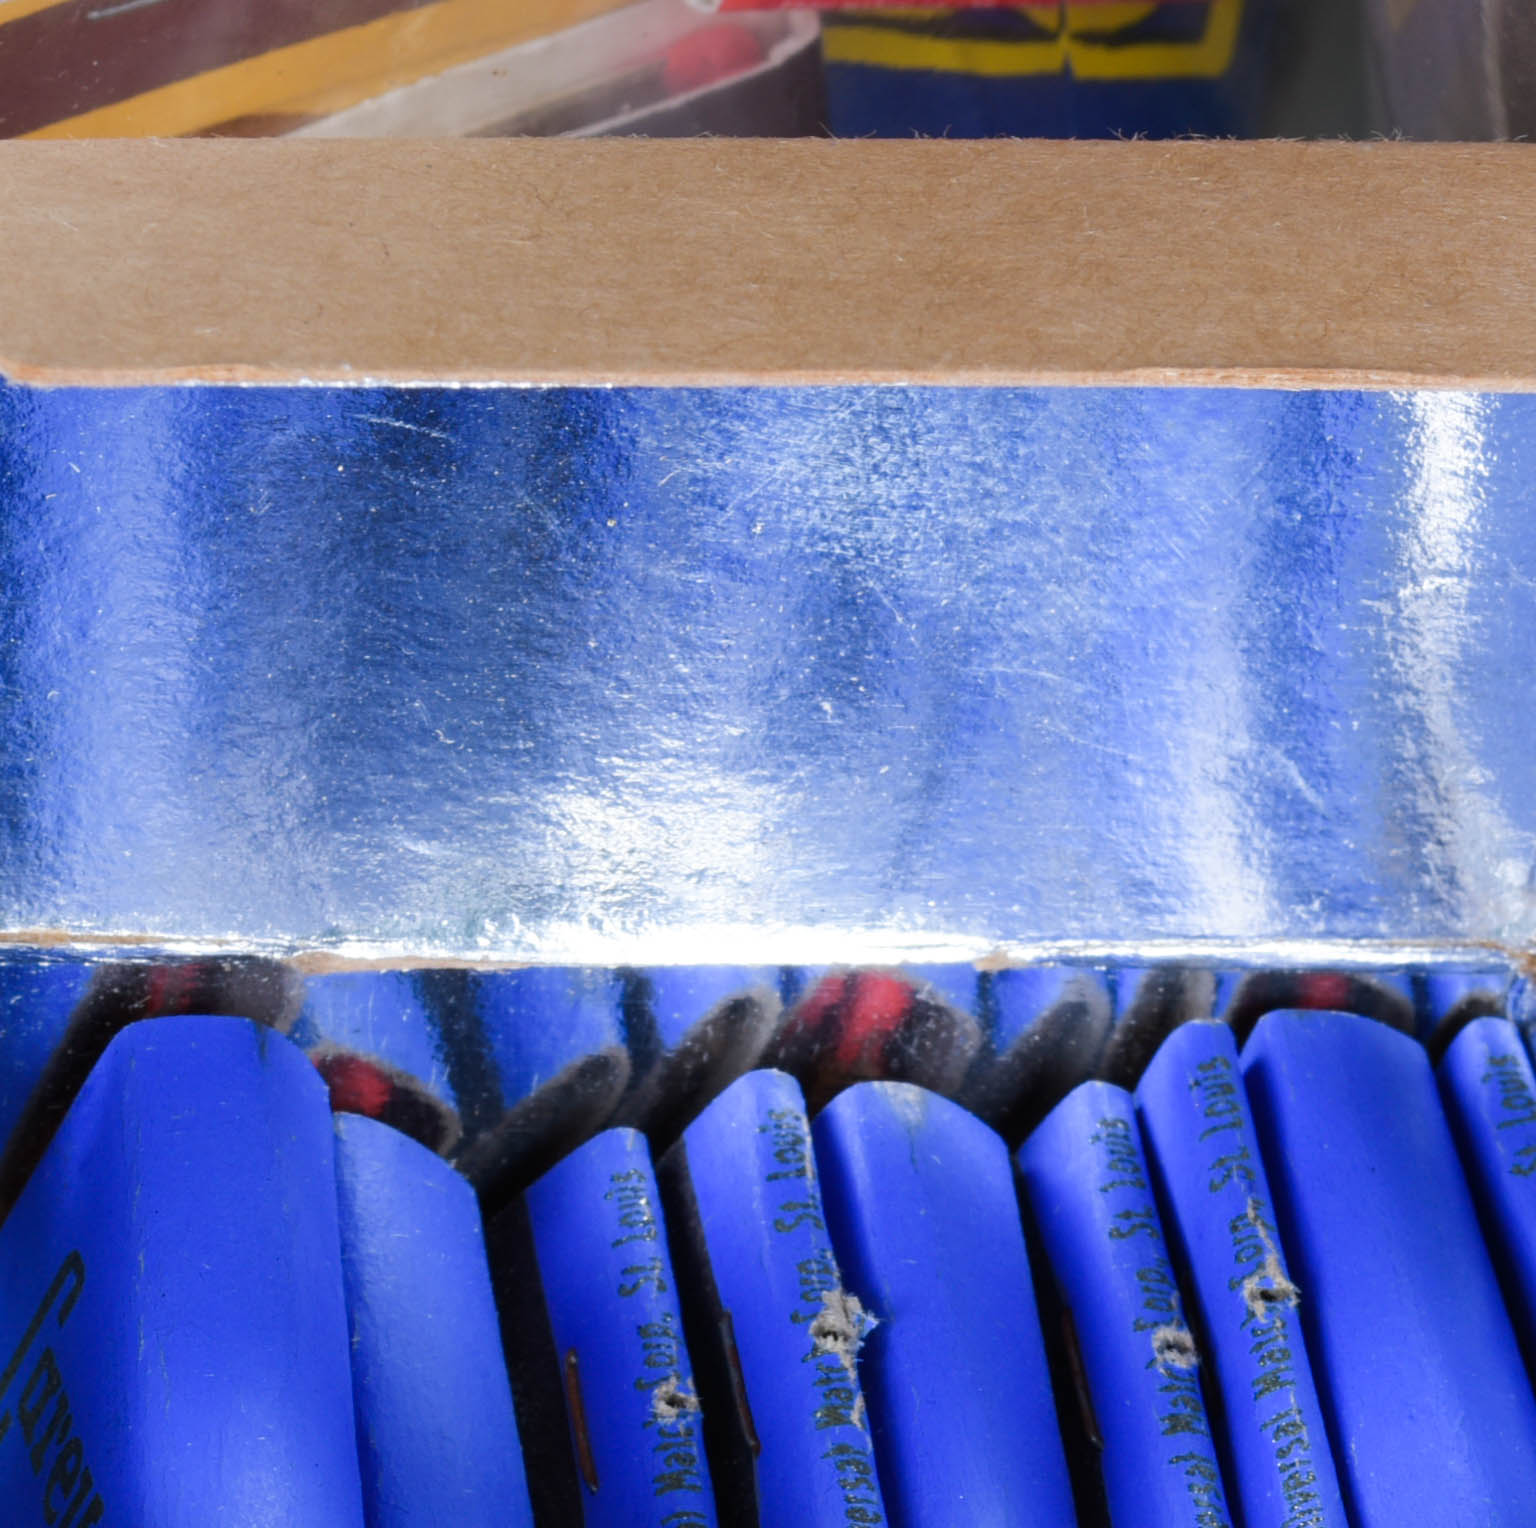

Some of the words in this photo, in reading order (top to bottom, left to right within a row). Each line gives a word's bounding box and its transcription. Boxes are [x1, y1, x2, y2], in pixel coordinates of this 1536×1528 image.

[1188, 1055, 1244, 1142] Louis
[758, 1107, 806, 1183] Louis
[1089, 1116, 1146, 1194] Louis
[604, 1168, 658, 1248] Louis
